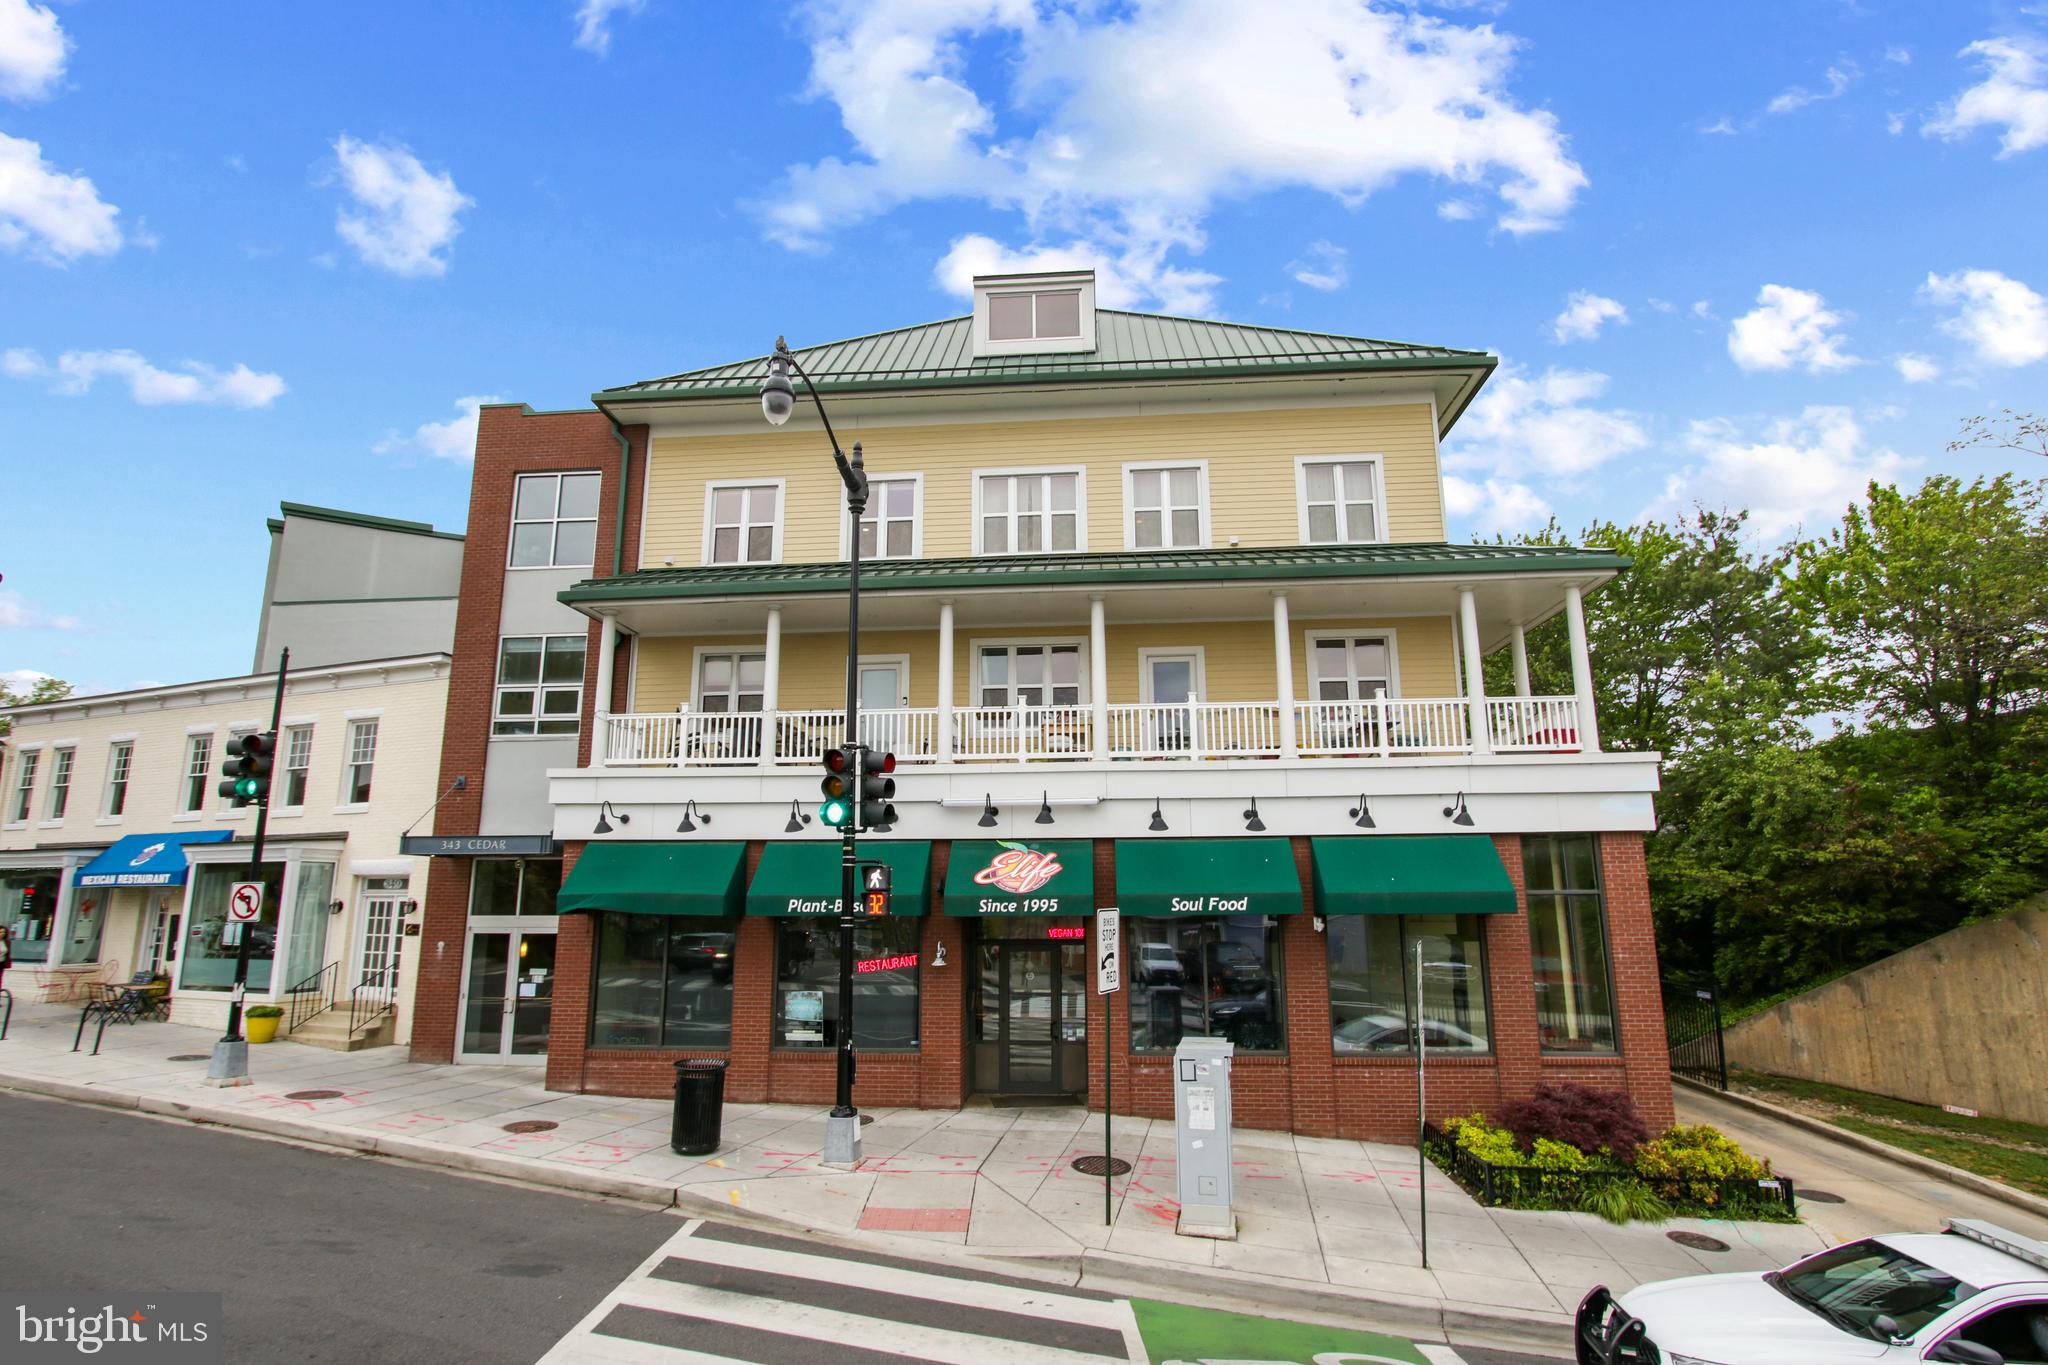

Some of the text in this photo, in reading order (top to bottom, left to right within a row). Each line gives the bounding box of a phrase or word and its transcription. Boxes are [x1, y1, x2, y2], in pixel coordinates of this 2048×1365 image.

[440, 840, 507, 850] 343 CEDAR
[80, 873, 171, 886] MEXICAN RESTAURANT
[869, 894, 885, 914] 32
[978, 898, 1058, 913] Since 1995
[1171, 896, 1248, 911] Soul Food
[1048, 928, 1073, 938] VEGAN
[1102, 928, 1116, 941] STOP
[857, 954, 918, 973] RESTAURANT
[1106, 970, 1117, 983] RED
